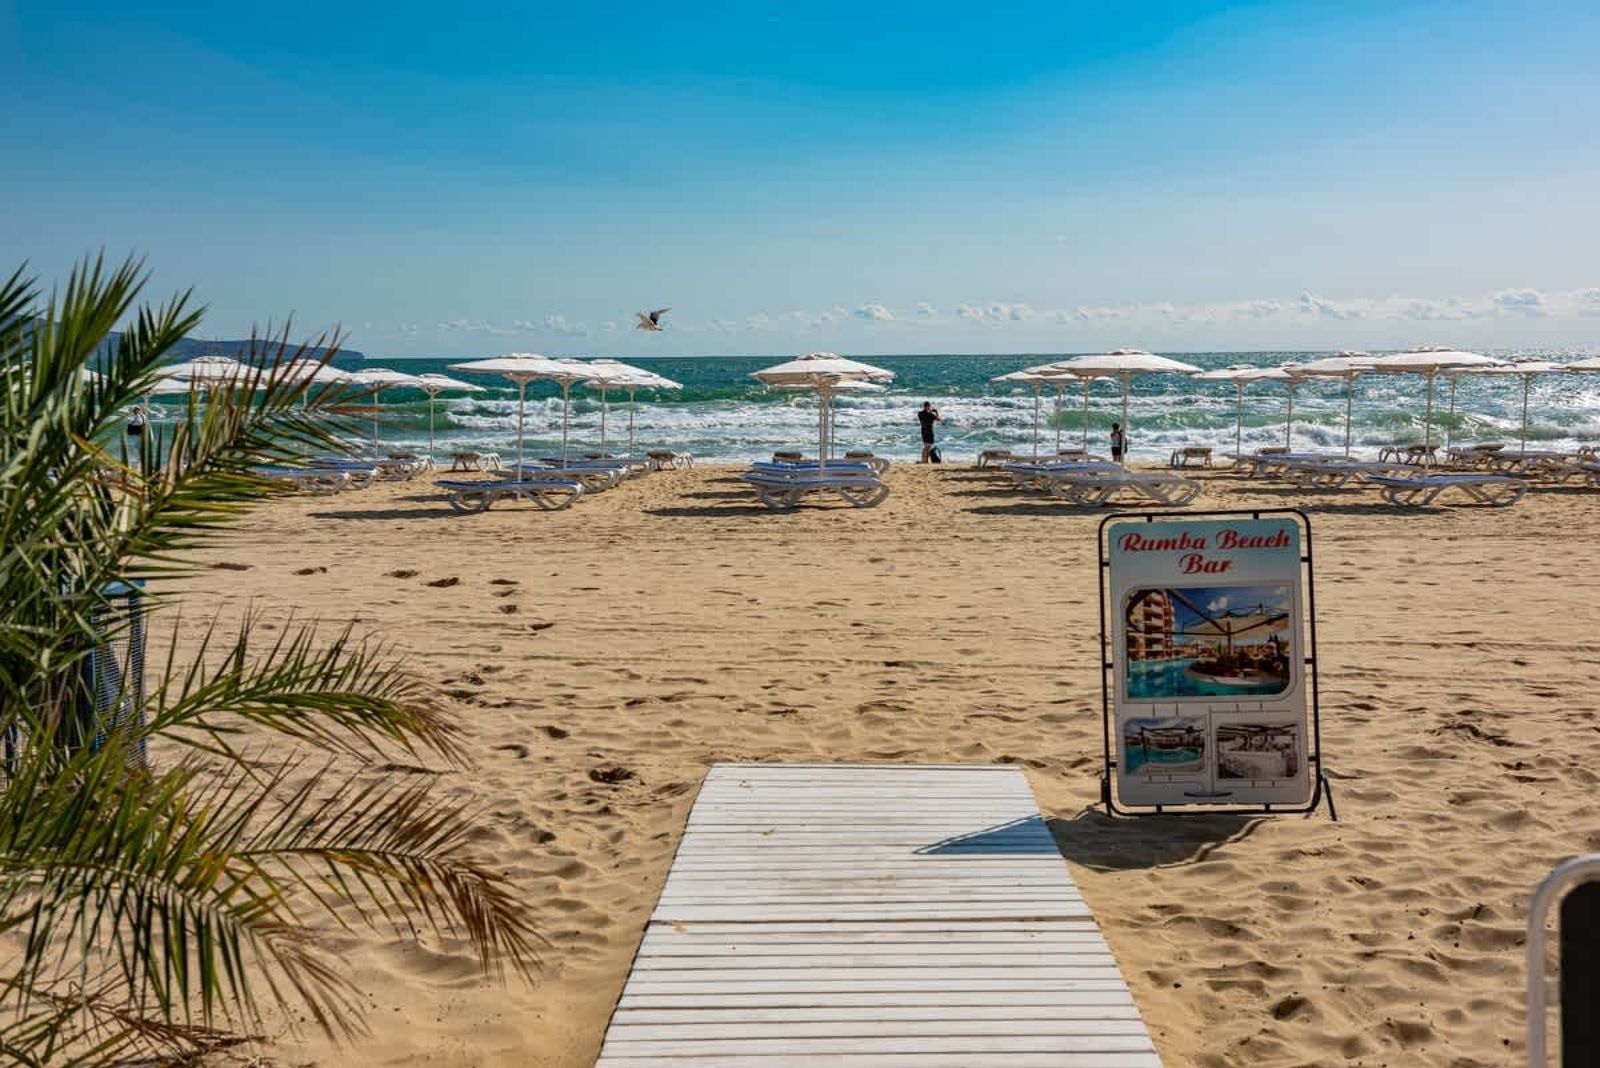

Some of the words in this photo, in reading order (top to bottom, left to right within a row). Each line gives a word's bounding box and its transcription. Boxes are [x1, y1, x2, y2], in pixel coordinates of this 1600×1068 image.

[1119, 531, 1207, 552] Rumba
[1215, 528, 1291, 549] Beach
[1179, 553, 1232, 574] Bar
